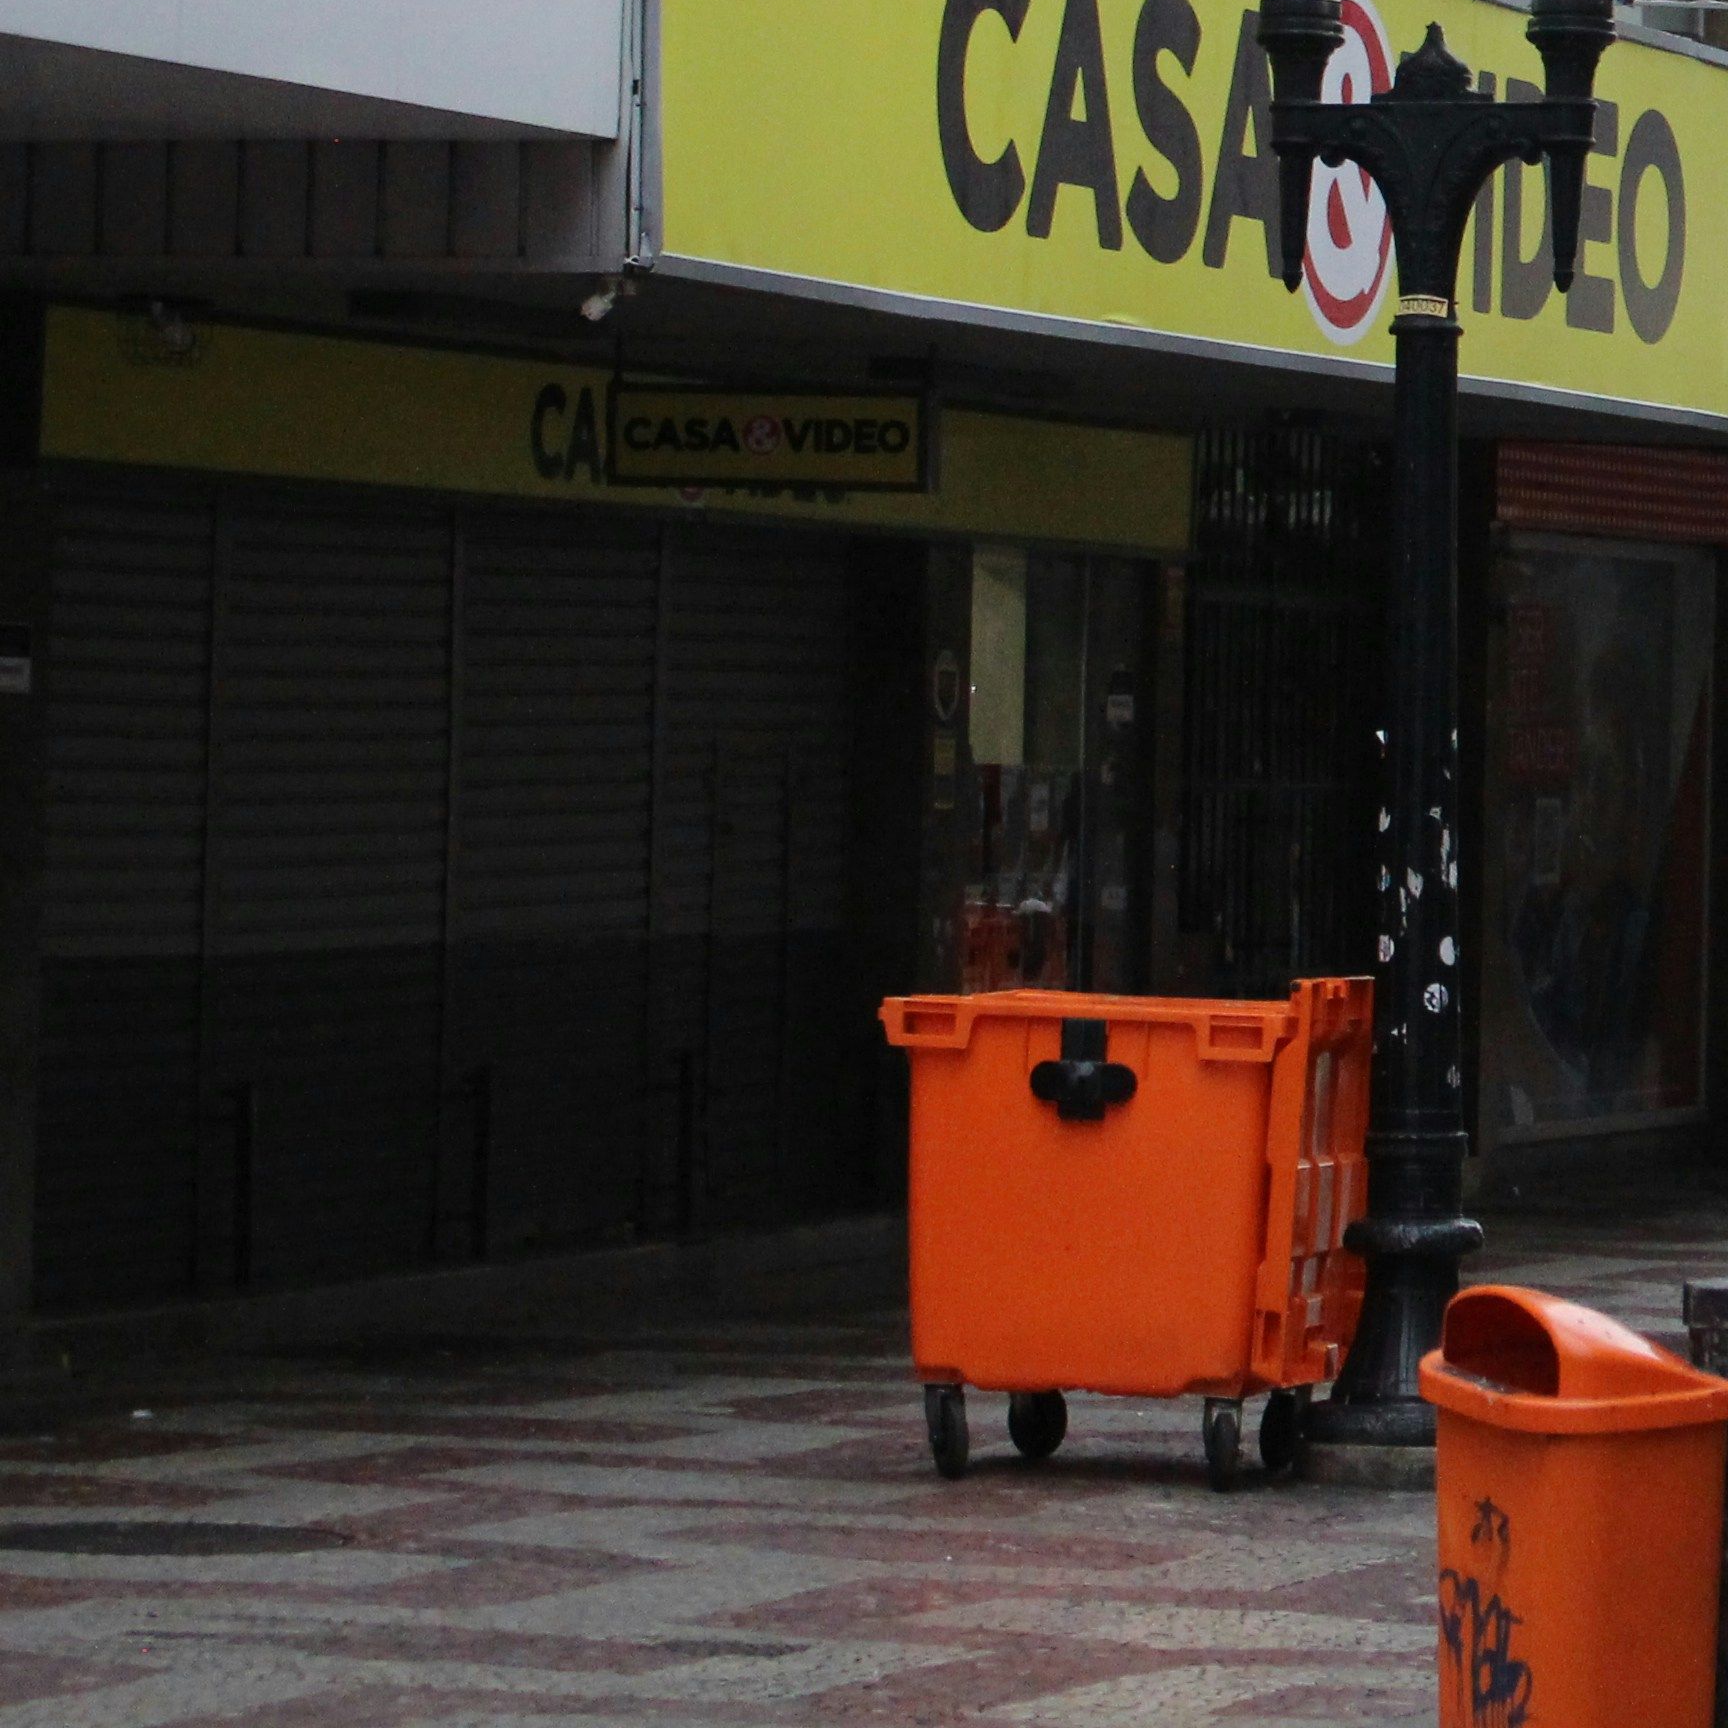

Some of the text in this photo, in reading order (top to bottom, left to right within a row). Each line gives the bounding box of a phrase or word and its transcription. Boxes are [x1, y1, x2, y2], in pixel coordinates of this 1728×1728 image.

[1402, 52, 1687, 346] IDEO
[624, 417, 740, 453] CASA
[782, 418, 910, 454] VIDEO
